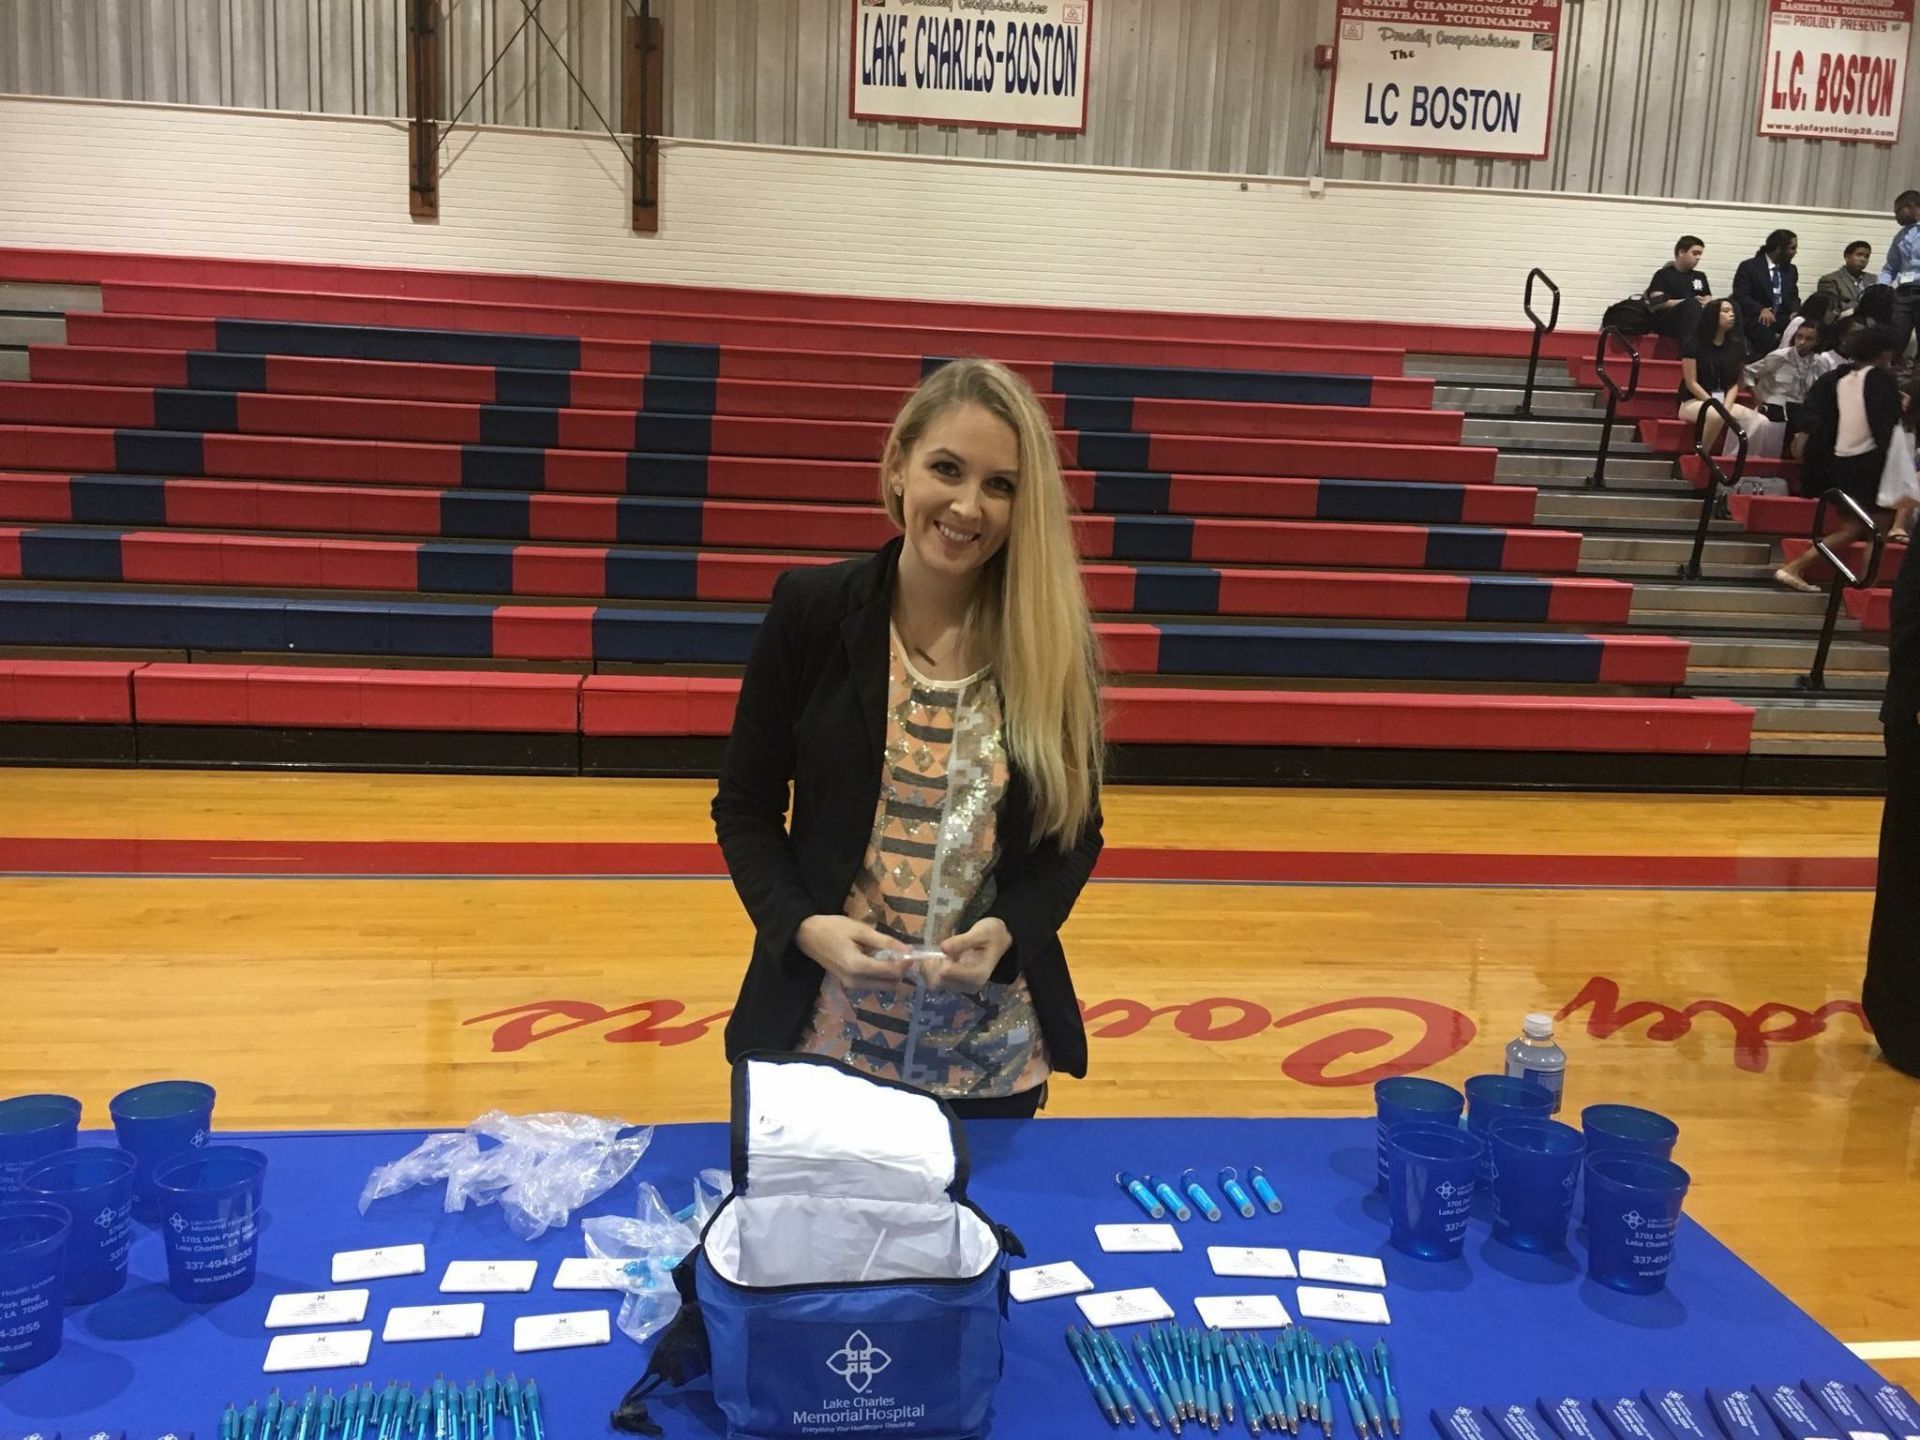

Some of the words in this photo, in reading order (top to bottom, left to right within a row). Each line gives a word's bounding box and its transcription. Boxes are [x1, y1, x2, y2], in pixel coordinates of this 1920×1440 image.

[1413, 0, 1533, 17] CHAMPIONSHIP
[1779, 2, 1839, 14] BASKETBALL
[1841, 6, 1905, 19] TOURNAMENT
[1341, 7, 1440, 22] BASKETBALL
[1444, 14, 1552, 31] TOURNAMENT
[1793, 14, 1837, 29] PROUDLY
[1839, 18, 1889, 33] PRESENTS
[862, 13, 908, 87] LAKE
[914, 15, 1078, 97] CHARLES-BOSTON
[1390, 49, 1415, 61] The
[1771, 50, 1807, 112] L.C.
[1814, 52, 1897, 118] BOSTON
[1364, 82, 1400, 126] LC
[1410, 85, 1521, 133] BOSTON
[823, 1398, 850, 1410] Lake
[853, 1395, 895, 1408] Charles
[793, 1408, 863, 1424] Memorial
[865, 1403, 925, 1422] Hospital
